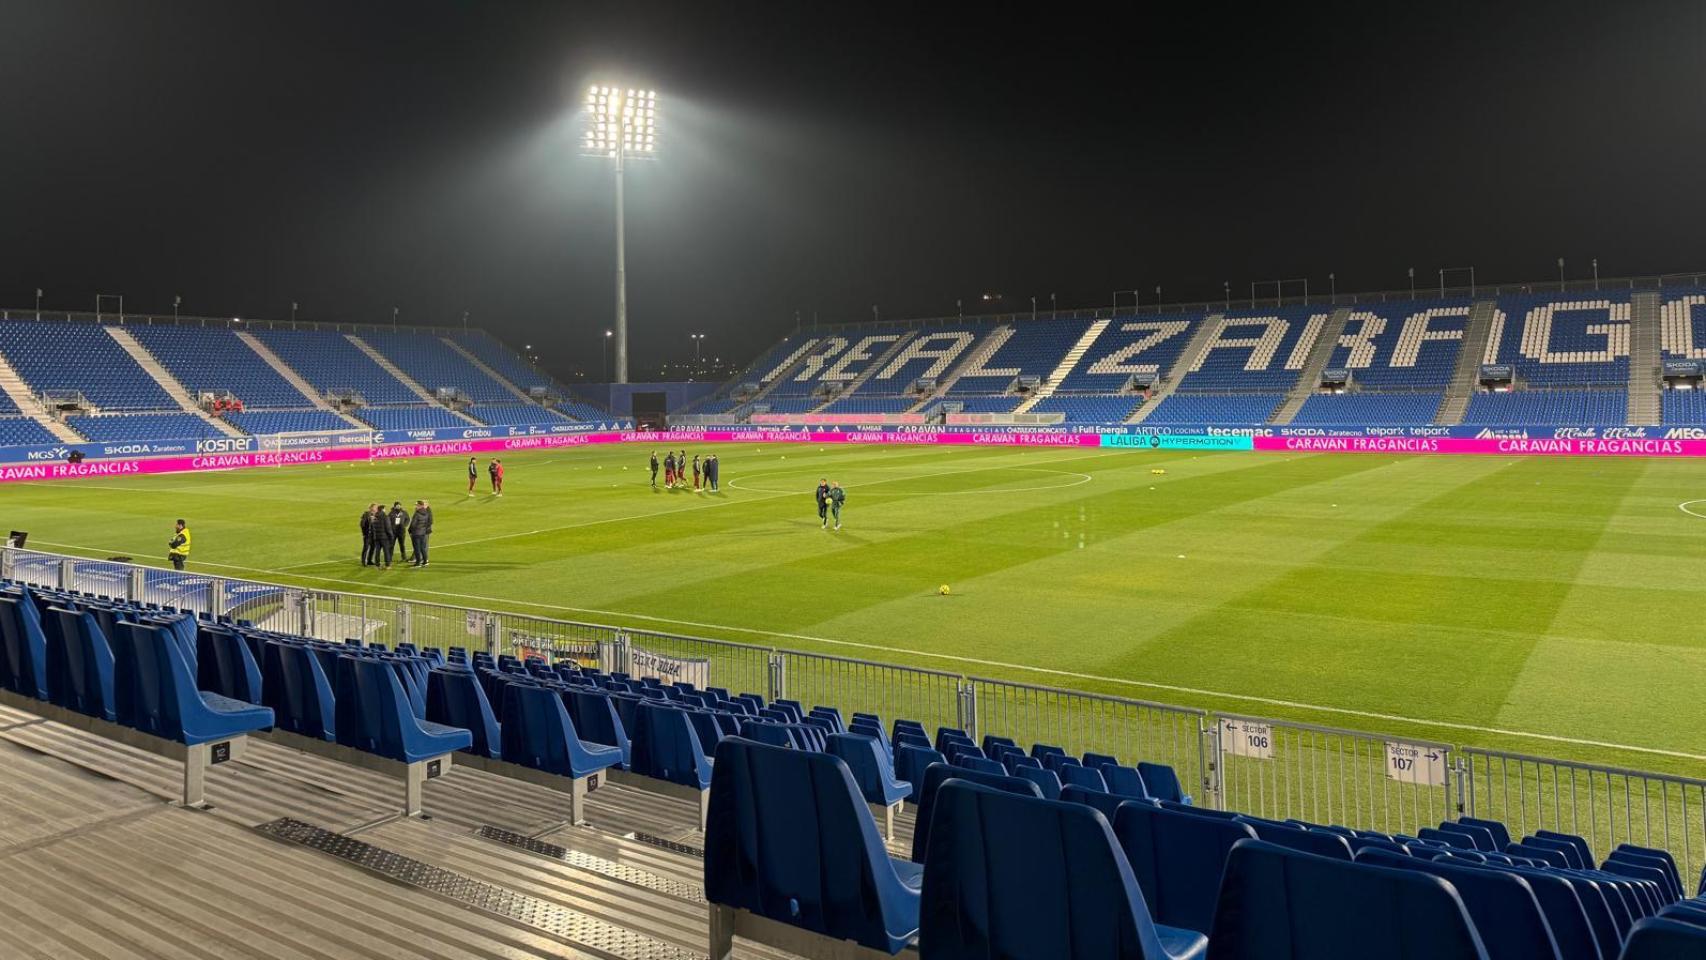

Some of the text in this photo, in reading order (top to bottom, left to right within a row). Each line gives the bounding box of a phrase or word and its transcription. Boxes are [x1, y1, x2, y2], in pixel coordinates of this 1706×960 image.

[761, 331, 1021, 382] REAL
[463, 429, 492, 438] embou
[1079, 426, 1095, 434] Full
[1207, 426, 1273, 437] tecemac
[1366, 426, 1404, 437] telpark
[1410, 426, 1450, 437] telpark
[732, 432, 763, 440] CARAVAN
[846, 432, 883, 442] CARAVAN
[973, 434, 1080, 444] CARAVAN FRAGANCIAS
[1110, 436, 1146, 446] LALIGA
[419, 442, 473, 454] FRAGANCIAS
[504, 438, 540, 448] CARAVAN
[1286, 438, 1438, 451] CARAVAN FRAGANCIAS
[1499, 440, 1682, 453] CARAVAN FRAGANCIAS
[28, 450, 54, 460] MGS
[192, 452, 323, 468] CARAVAN FRAGANCIAS
[53, 462, 139, 476] FRAGANCIAS
[1242, 725, 1267, 734] SECTOR
[1248, 735, 1268, 748] 106
[1391, 747, 1418, 758] SECTOR
[1392, 757, 1412, 771] 107
